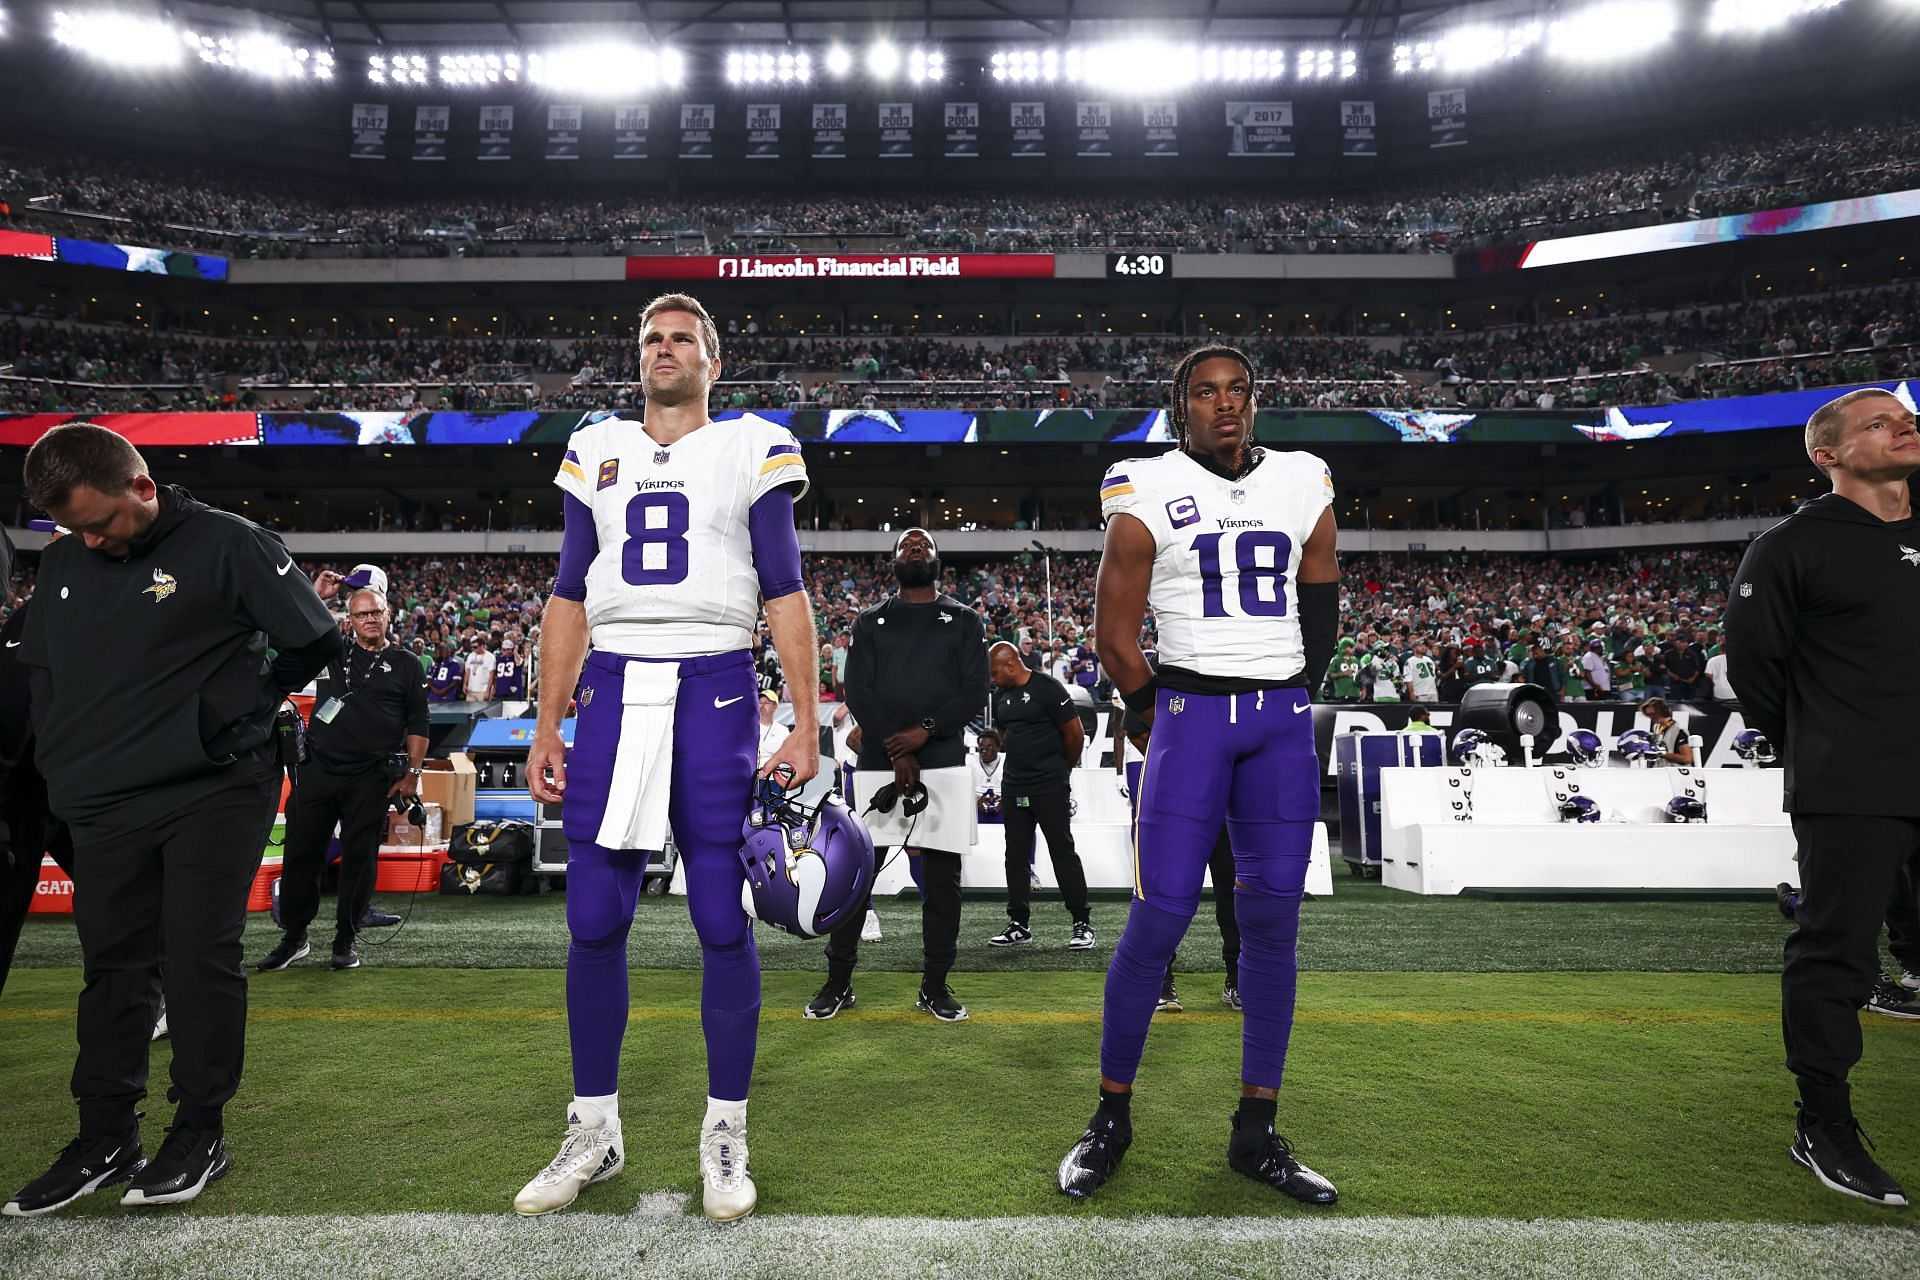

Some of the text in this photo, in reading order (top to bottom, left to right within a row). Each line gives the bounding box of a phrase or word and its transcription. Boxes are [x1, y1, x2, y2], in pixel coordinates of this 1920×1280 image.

[751, 117, 777, 129] 2001
[816, 117, 843, 129] 2002
[948, 115, 976, 127] 2004
[1254, 111, 1282, 122] 2017
[1256, 127, 1284, 135] WORLD
[740, 256, 960, 277] Lincoln Financial Field
[1115, 255, 1164, 275] 4:30
[1168, 498, 1196, 521] C
[621, 491, 690, 586] 8
[1189, 530, 1292, 618] 18
[437, 667, 448, 680] 8
[497, 661, 514, 678] 93
